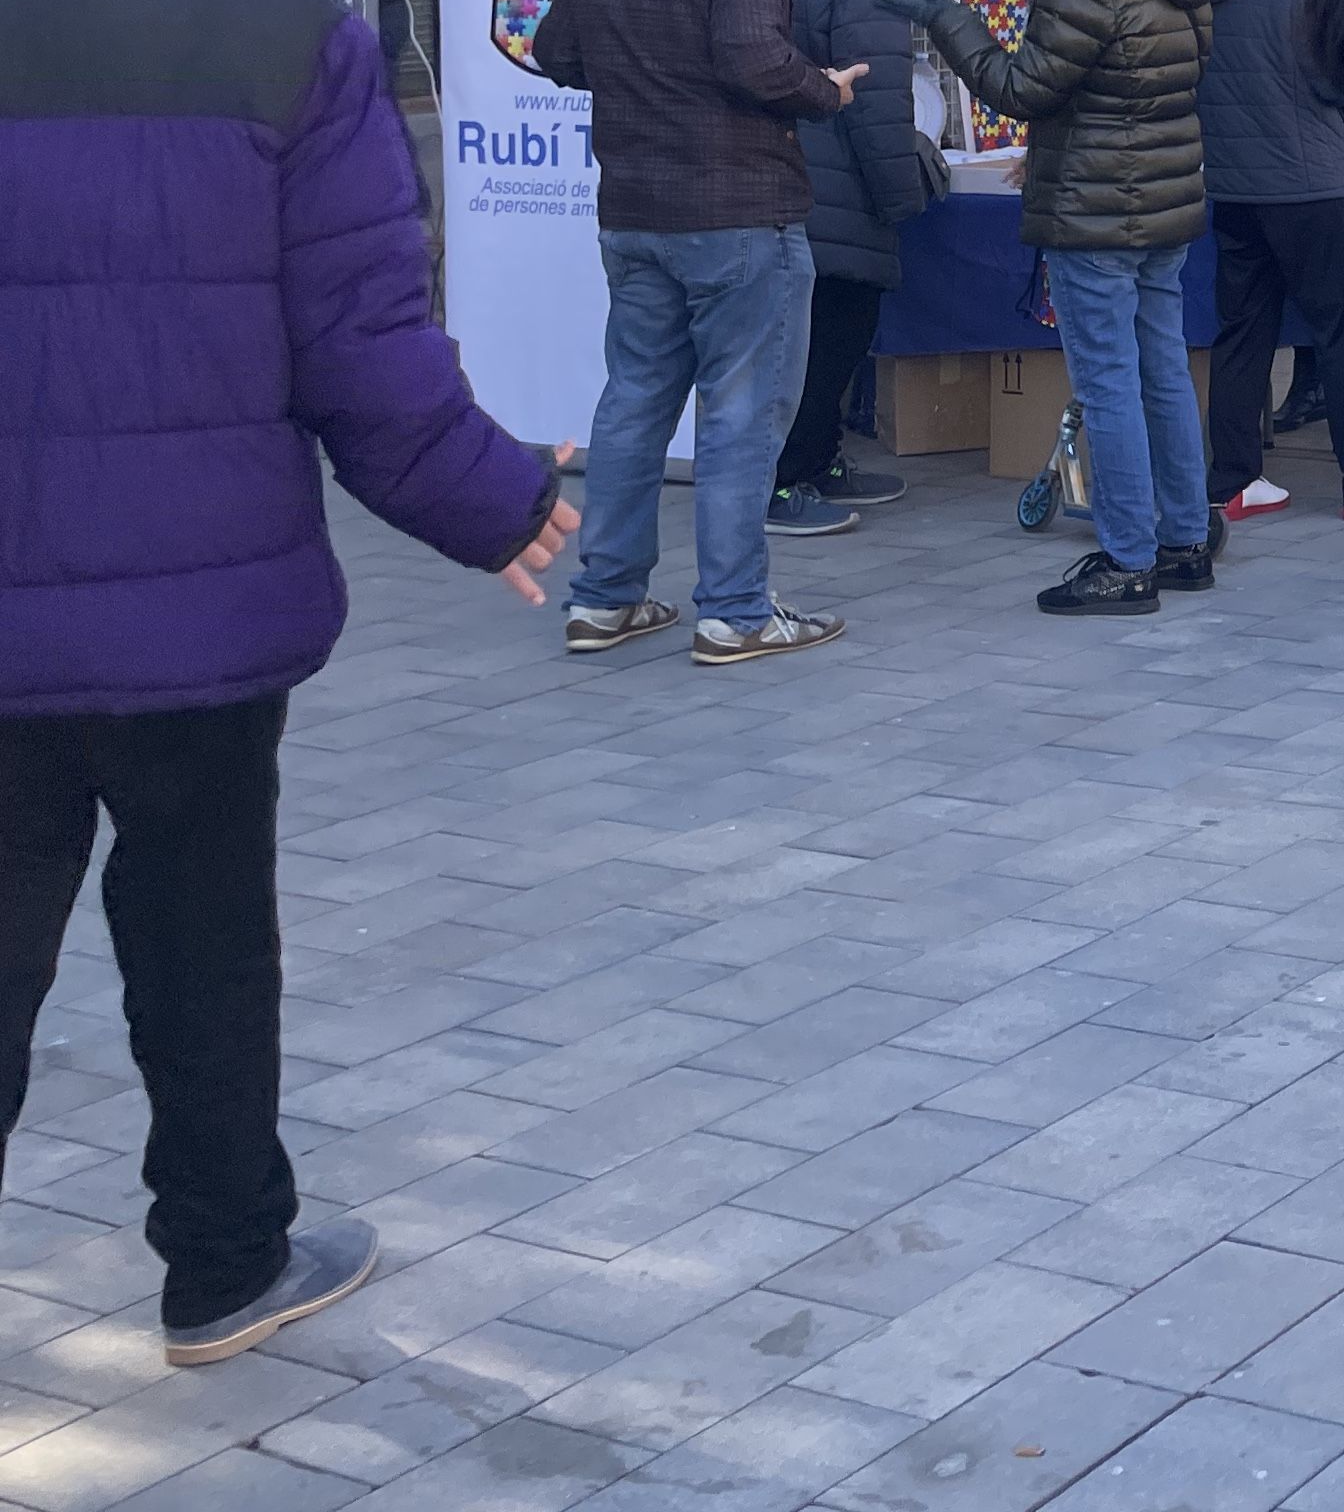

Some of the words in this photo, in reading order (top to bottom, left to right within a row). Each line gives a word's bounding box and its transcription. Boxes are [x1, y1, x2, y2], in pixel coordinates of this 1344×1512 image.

[458, 120, 562, 168] Rubí
[480, 177, 567, 196] Associació
[571, 180, 591, 198] de
[469, 195, 489, 212] de
[493, 200, 566, 217] persones
[571, 202, 598, 217] am
